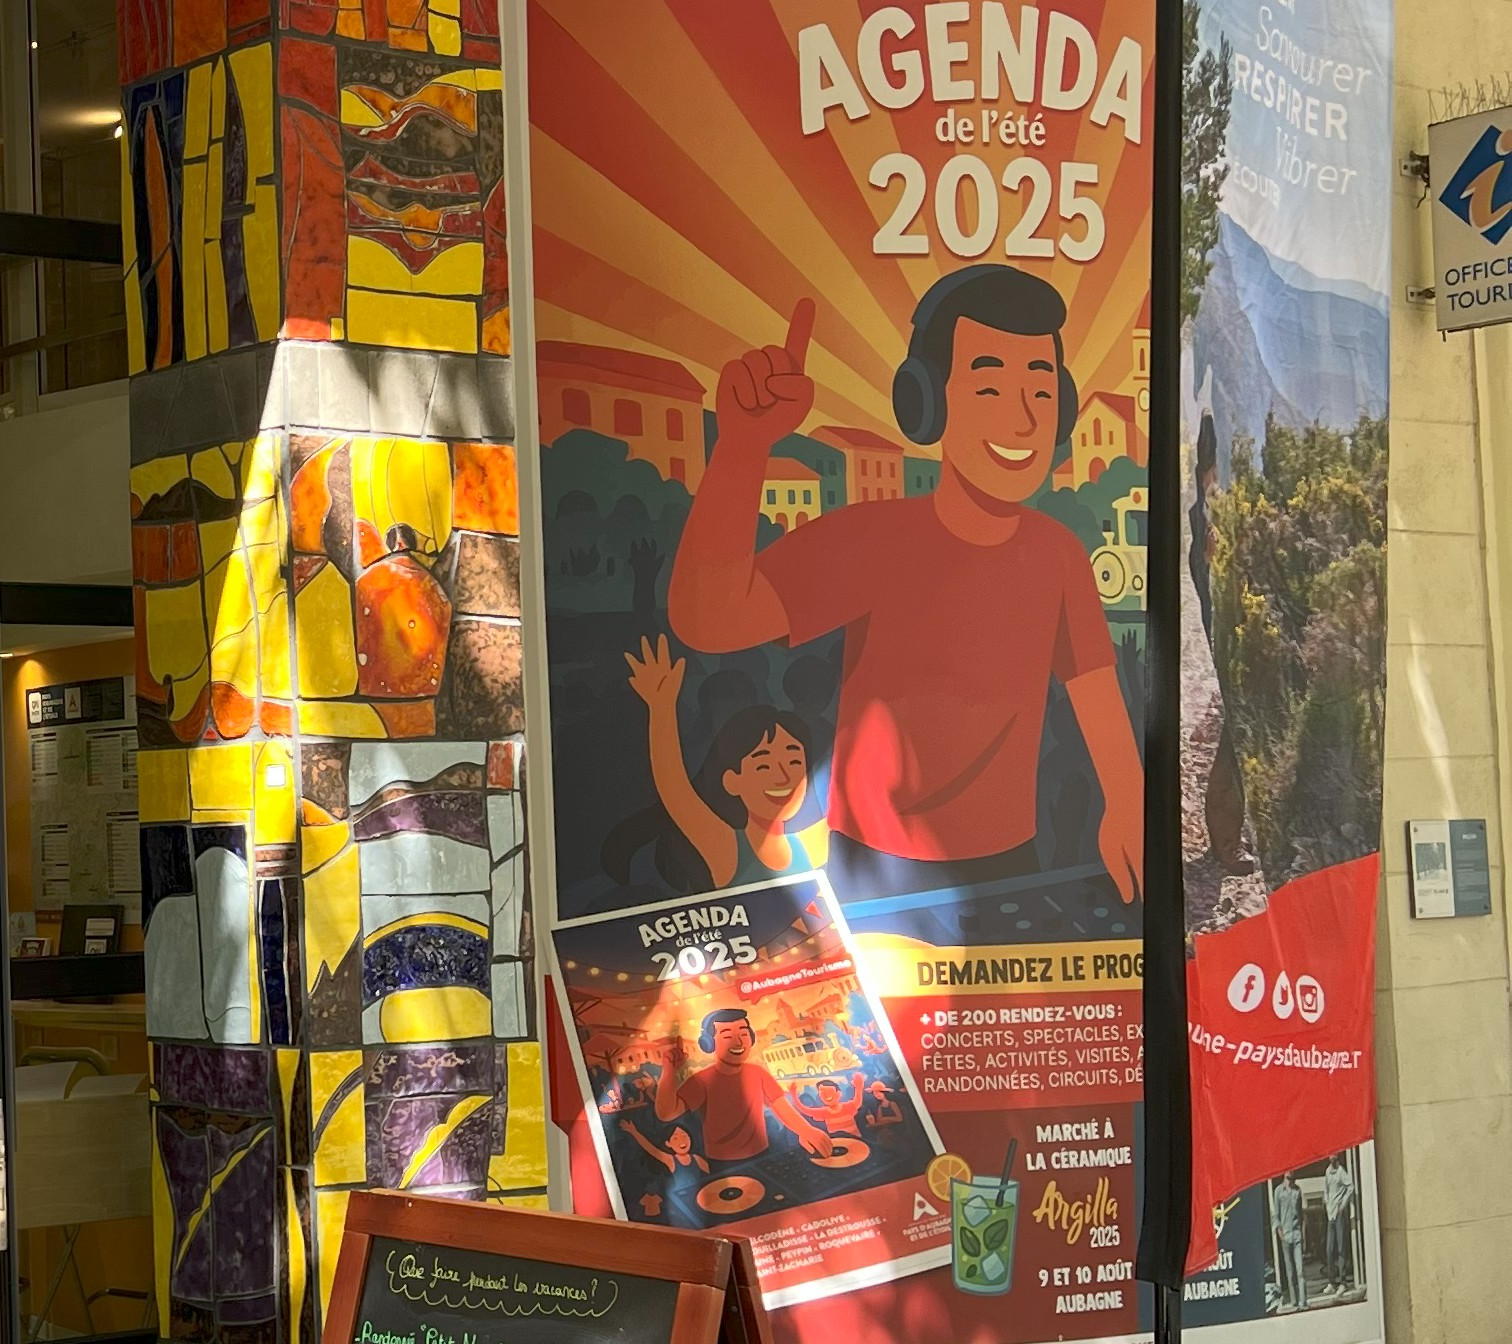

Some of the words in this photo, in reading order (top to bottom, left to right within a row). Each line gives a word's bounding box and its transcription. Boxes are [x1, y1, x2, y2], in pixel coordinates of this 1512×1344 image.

[798, 1, 1142, 145] AGENDA
[1233, 52, 1348, 141] RESPIRER
[935, 108, 975, 143] de
[981, 109, 1046, 146] l'été
[868, 153, 1106, 262] 2025
[638, 905, 750, 948] AGENDA
[676, 936, 693, 948] de
[693, 929, 723, 945] l'été
[651, 935, 758, 982] 2025
[917, 958, 1053, 986] DEMANDEZ
[1062, 956, 1086, 982] LE
[740, 958, 852, 994] @AubagneTourisme
[935, 1010, 958, 1026] DE
[961, 1009, 997, 1026] 200
[921, 1030, 1019, 1049] CONCERTS,
[1023, 1025, 1124, 1045] SPECTACLES,
[923, 1052, 981, 1072] FÊTES,
[984, 1047, 1072, 1069] ACTIVITÉS,
[1075, 1046, 1134, 1065] VISITES,
[924, 1071, 1044, 1093] RANDONNÉES,
[1048, 1069, 1123, 1088] CIRCUITS,
[1036, 1117, 1099, 1143] MARCHÉ
[1104, 1117, 1115, 1139] À
[1026, 1152, 1047, 1171] LA
[1051, 1146, 1132, 1169] CÉRAMIQUE
[801, 1214, 845, 1232] CADOLIVE
[1032, 1176, 1118, 1246] Argilla
[814, 1231, 827, 1240] LA
[826, 1216, 882, 1237] DESTROUSSE
[1090, 1225, 1120, 1248] 2025
[781, 1244, 813, 1260] PEYPIN
[818, 1229, 875, 1250] ROQUEVAIRE
[399, 1254, 425, 1280] Que
[431, 1256, 461, 1289] faire
[462, 1271, 509, 1292] pendant
[1038, 1268, 1049, 1287] 9
[1053, 1267, 1071, 1287] ET
[1076, 1266, 1092, 1285] 10
[1096, 1259, 1133, 1282] AOÛT
[1055, 1290, 1123, 1314] AUBAGNE
[1183, 1277, 1241, 1301] AUBAGNE
